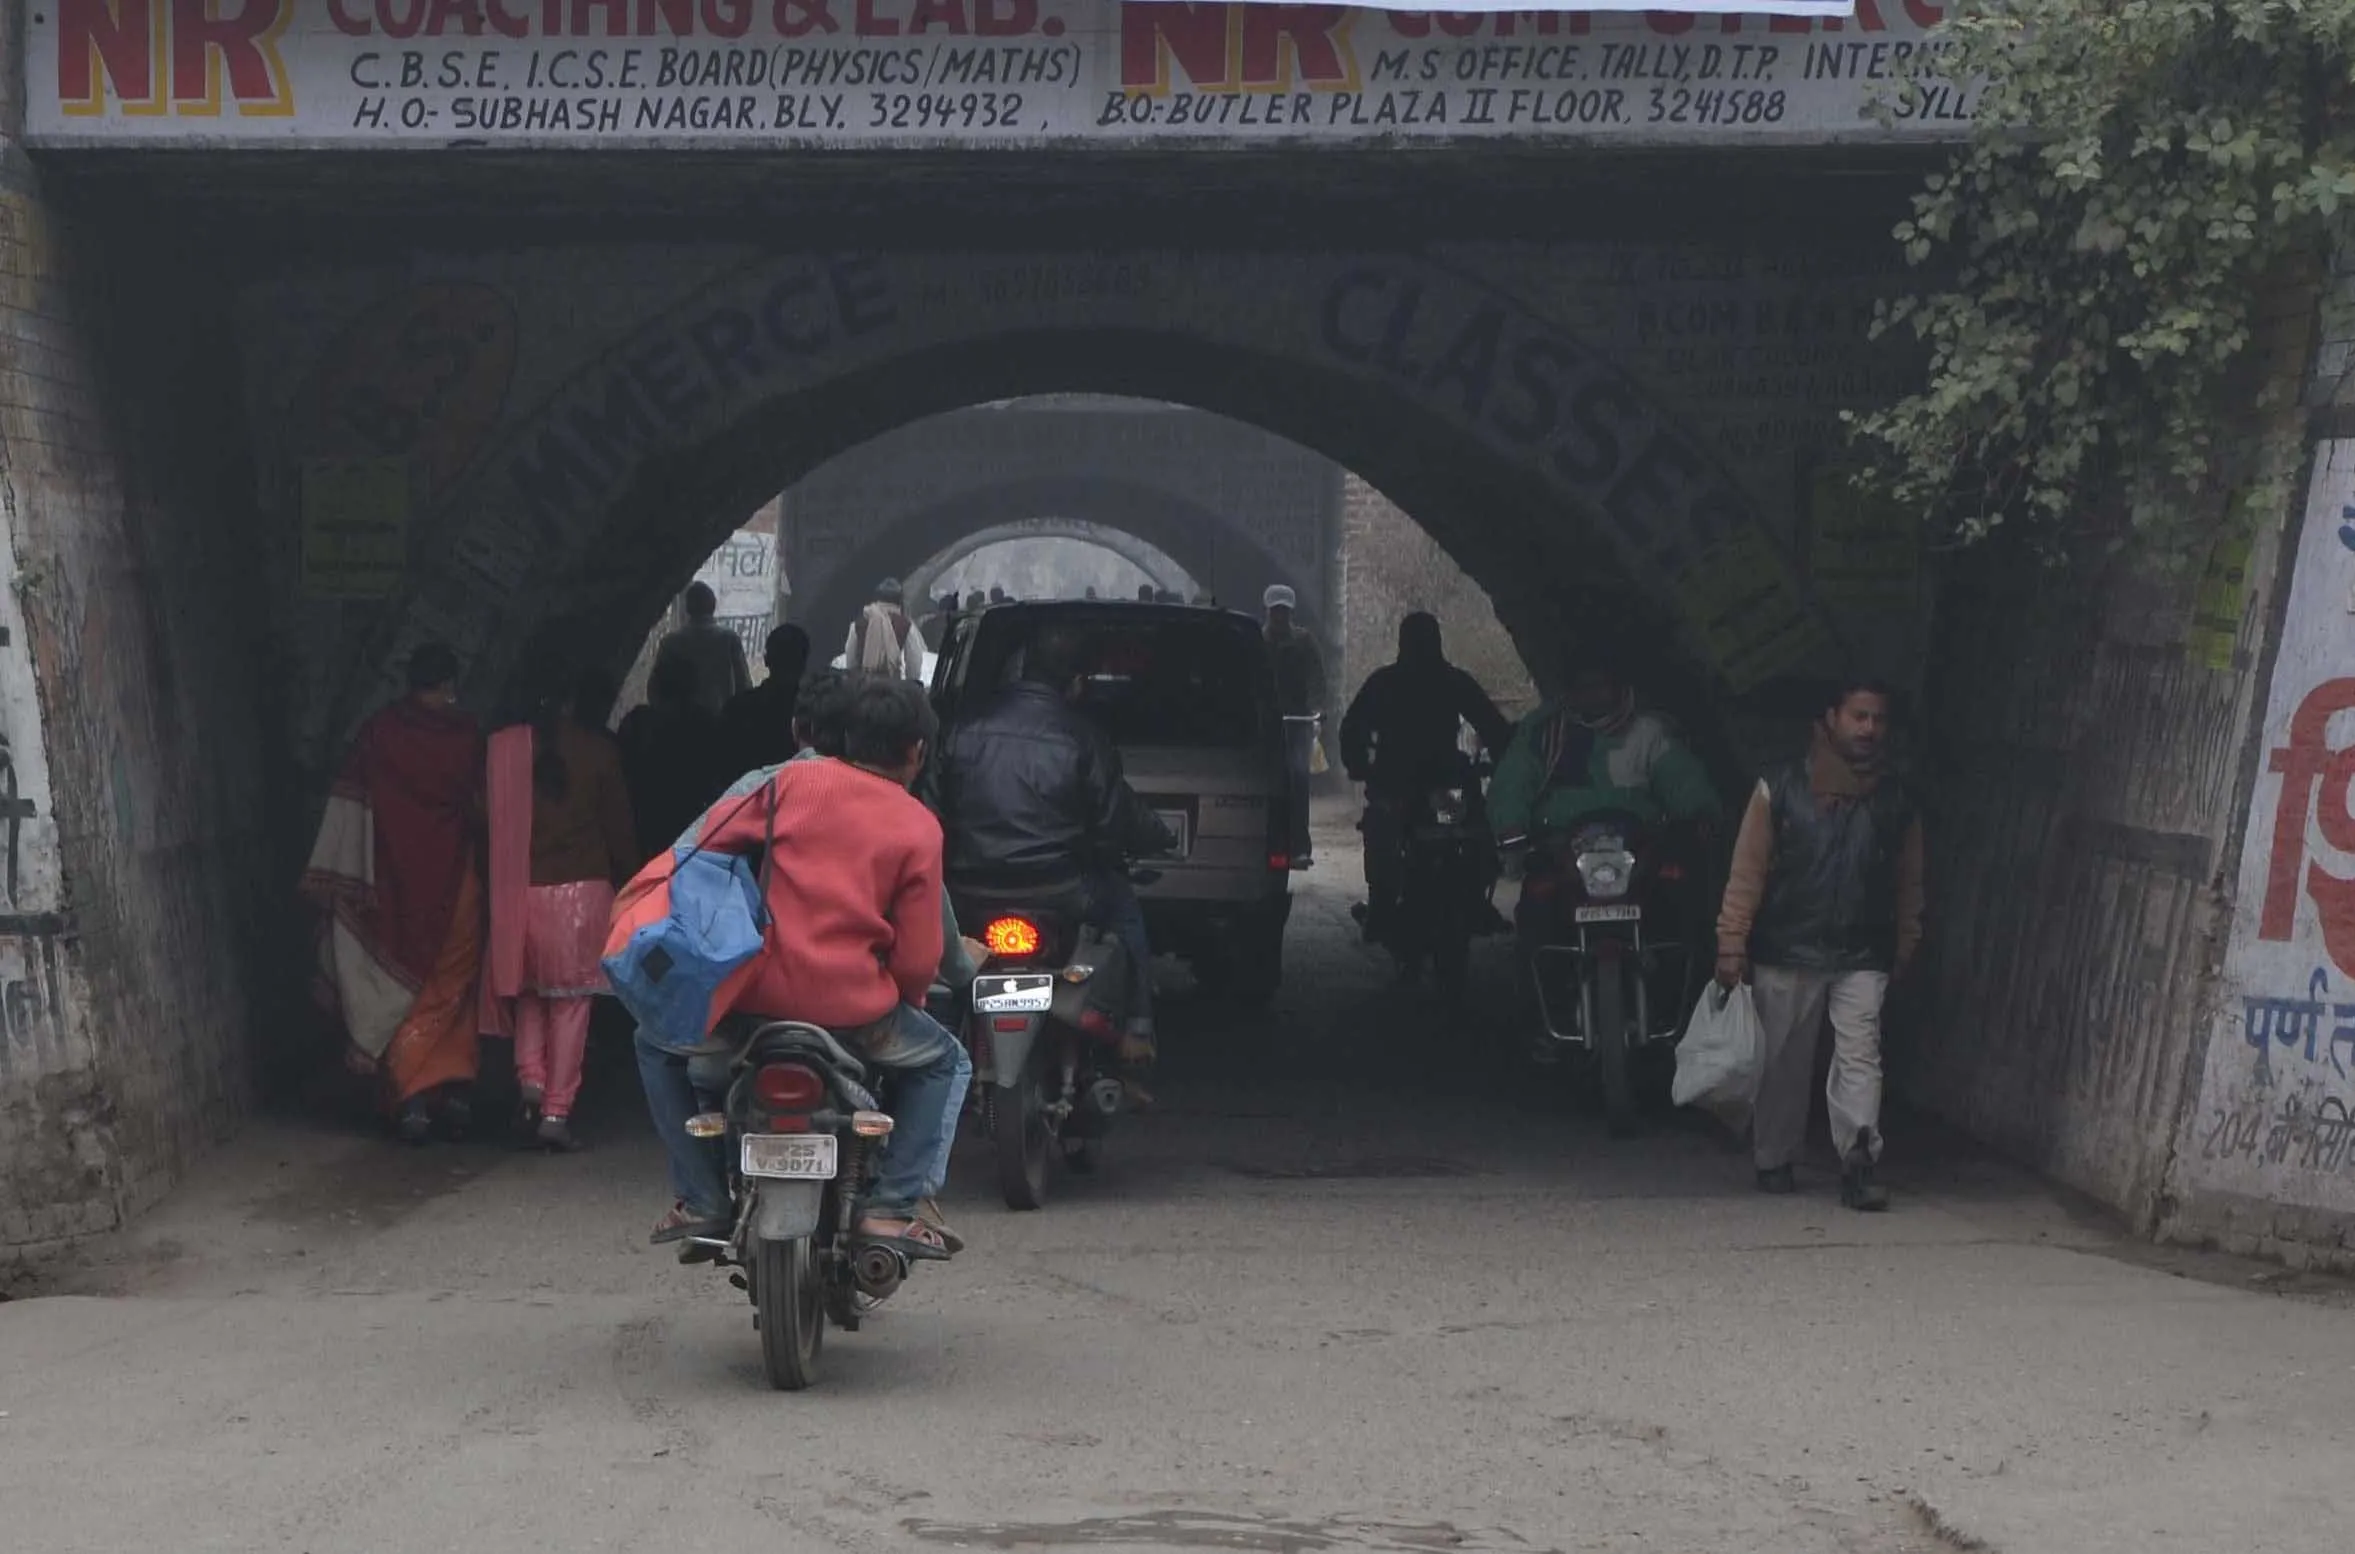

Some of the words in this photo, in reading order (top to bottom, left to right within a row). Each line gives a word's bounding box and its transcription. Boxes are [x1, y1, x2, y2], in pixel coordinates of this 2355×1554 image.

[450, 98, 622, 132] SUBHASH
[1328, 90, 1447, 126] PLAZA
[1647, 87, 1786, 125] 3241588
[504, 248, 899, 550] MMERCE
